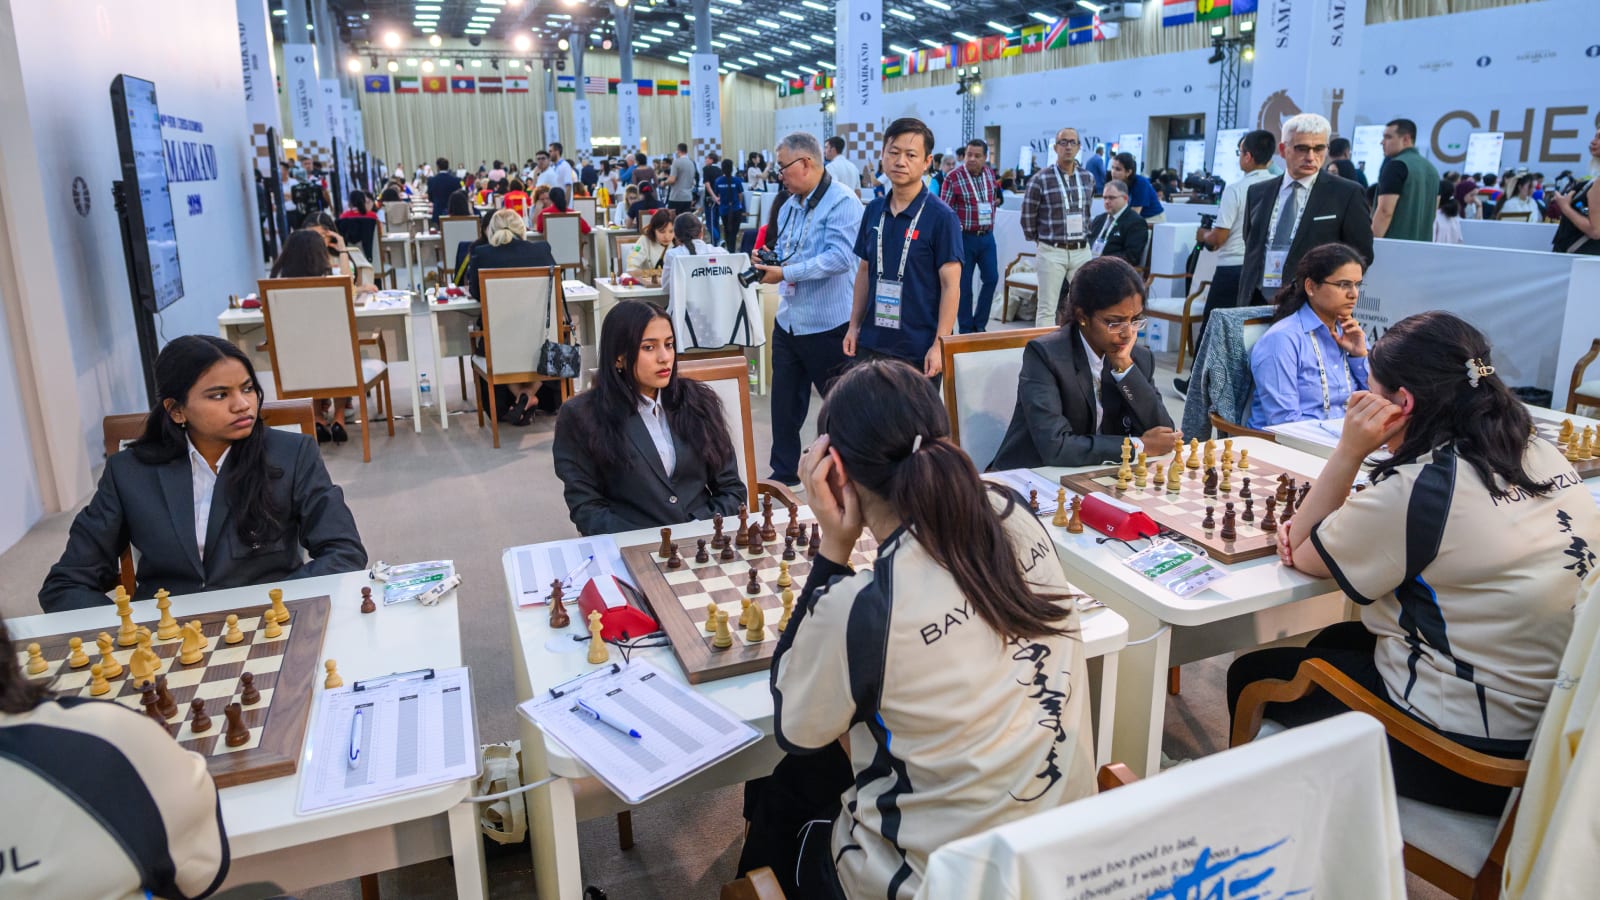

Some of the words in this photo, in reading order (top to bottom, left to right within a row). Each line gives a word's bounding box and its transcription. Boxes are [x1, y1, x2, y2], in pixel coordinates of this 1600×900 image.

[1331, 0, 1346, 47] SAM
[861, 42, 870, 106] SAMARKAND
[1430, 104, 1600, 164] CHE
[691, 265, 734, 278] ARMENIA
[1129, 845, 1159, 868] good
